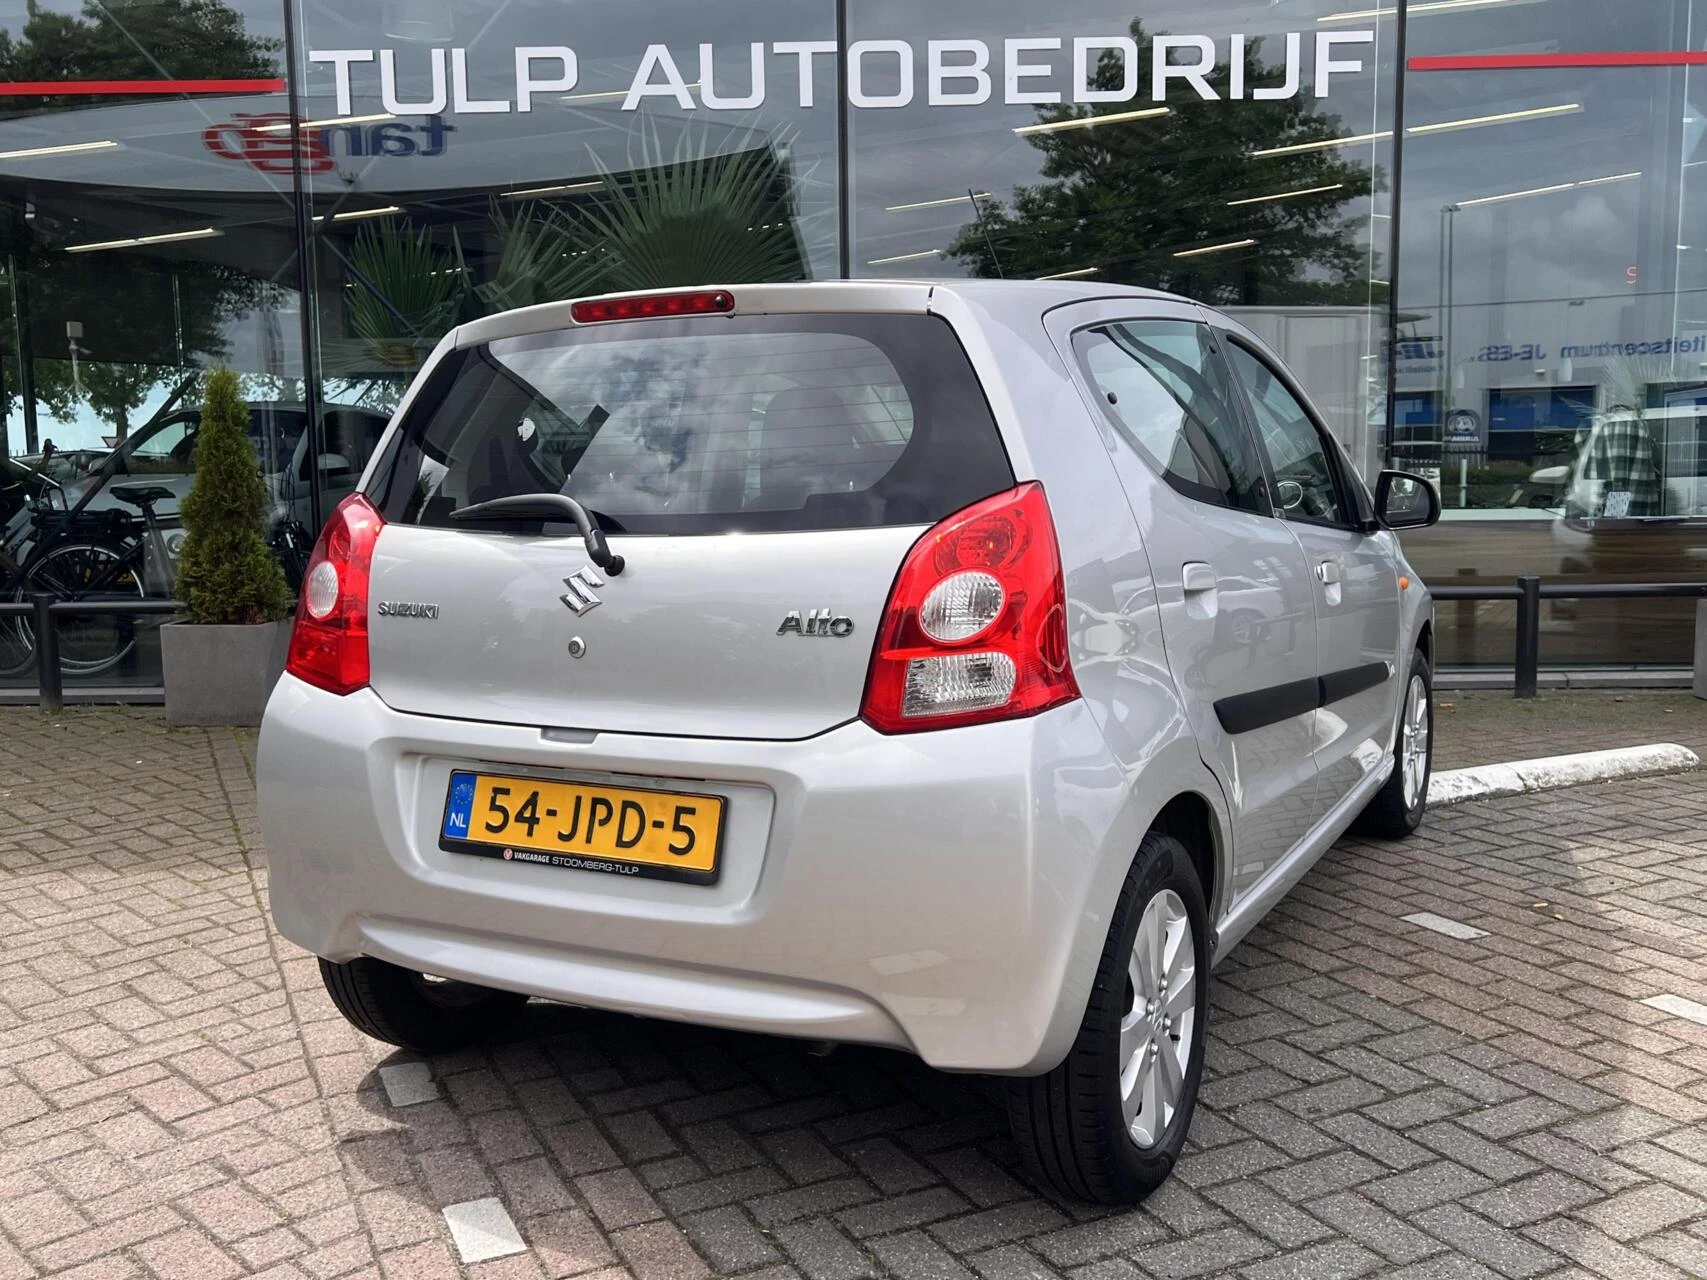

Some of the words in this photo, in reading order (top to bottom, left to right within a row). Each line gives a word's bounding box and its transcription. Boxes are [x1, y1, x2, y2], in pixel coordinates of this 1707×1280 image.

[309, 46, 579, 115] TULP
[621, 30, 1374, 111] AUTOBEDRIJF
[378, 601, 440, 620] SUZUKI
[776, 608, 855, 637] Alto
[449, 812, 467, 828] NL
[485, 786, 697, 856] 54-JPD-5
[514, 852, 550, 863] VAKGARAGE
[552, 856, 639, 875] STOOMBERG-TULP
